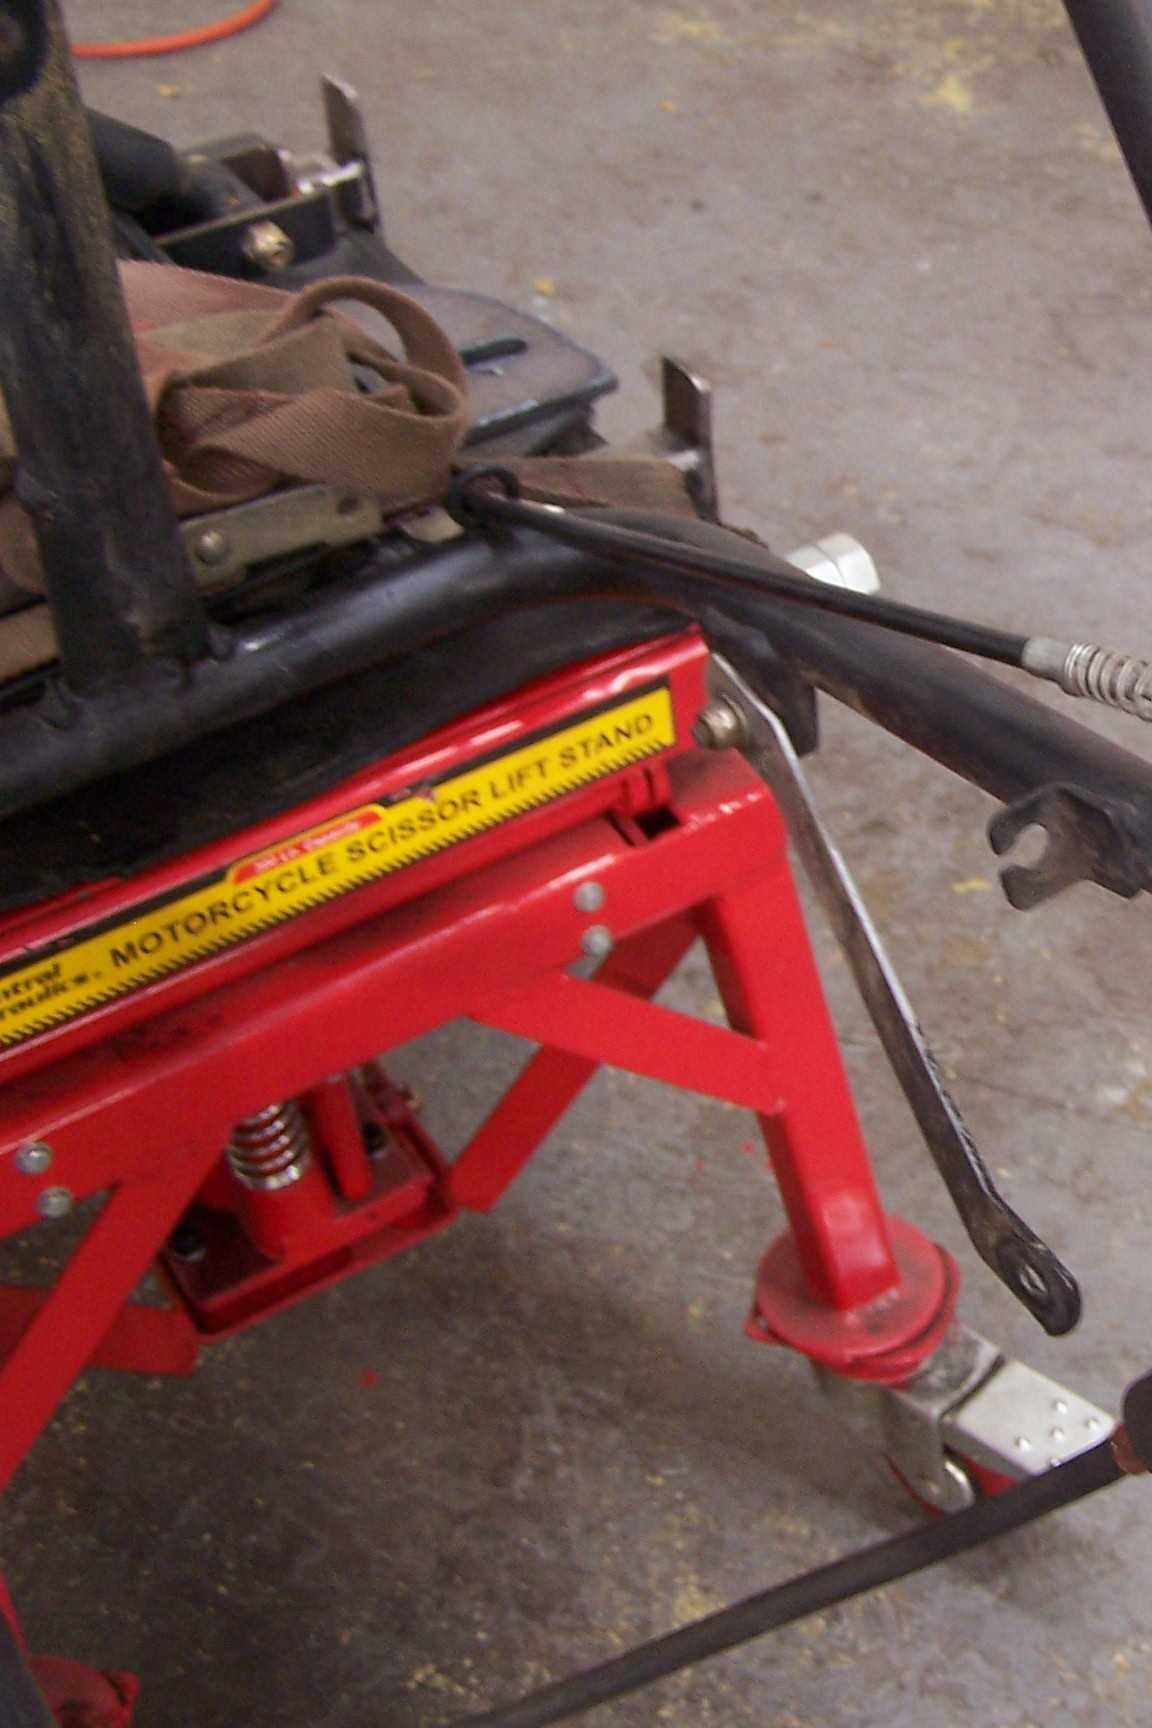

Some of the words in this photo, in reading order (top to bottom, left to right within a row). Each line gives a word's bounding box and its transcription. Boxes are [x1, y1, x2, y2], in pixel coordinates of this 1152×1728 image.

[110, 852, 334, 968] MOTORCYCLE
[346, 787, 480, 862] SCISSOR
[488, 758, 549, 799] LIFT
[560, 712, 653, 768] STAND
